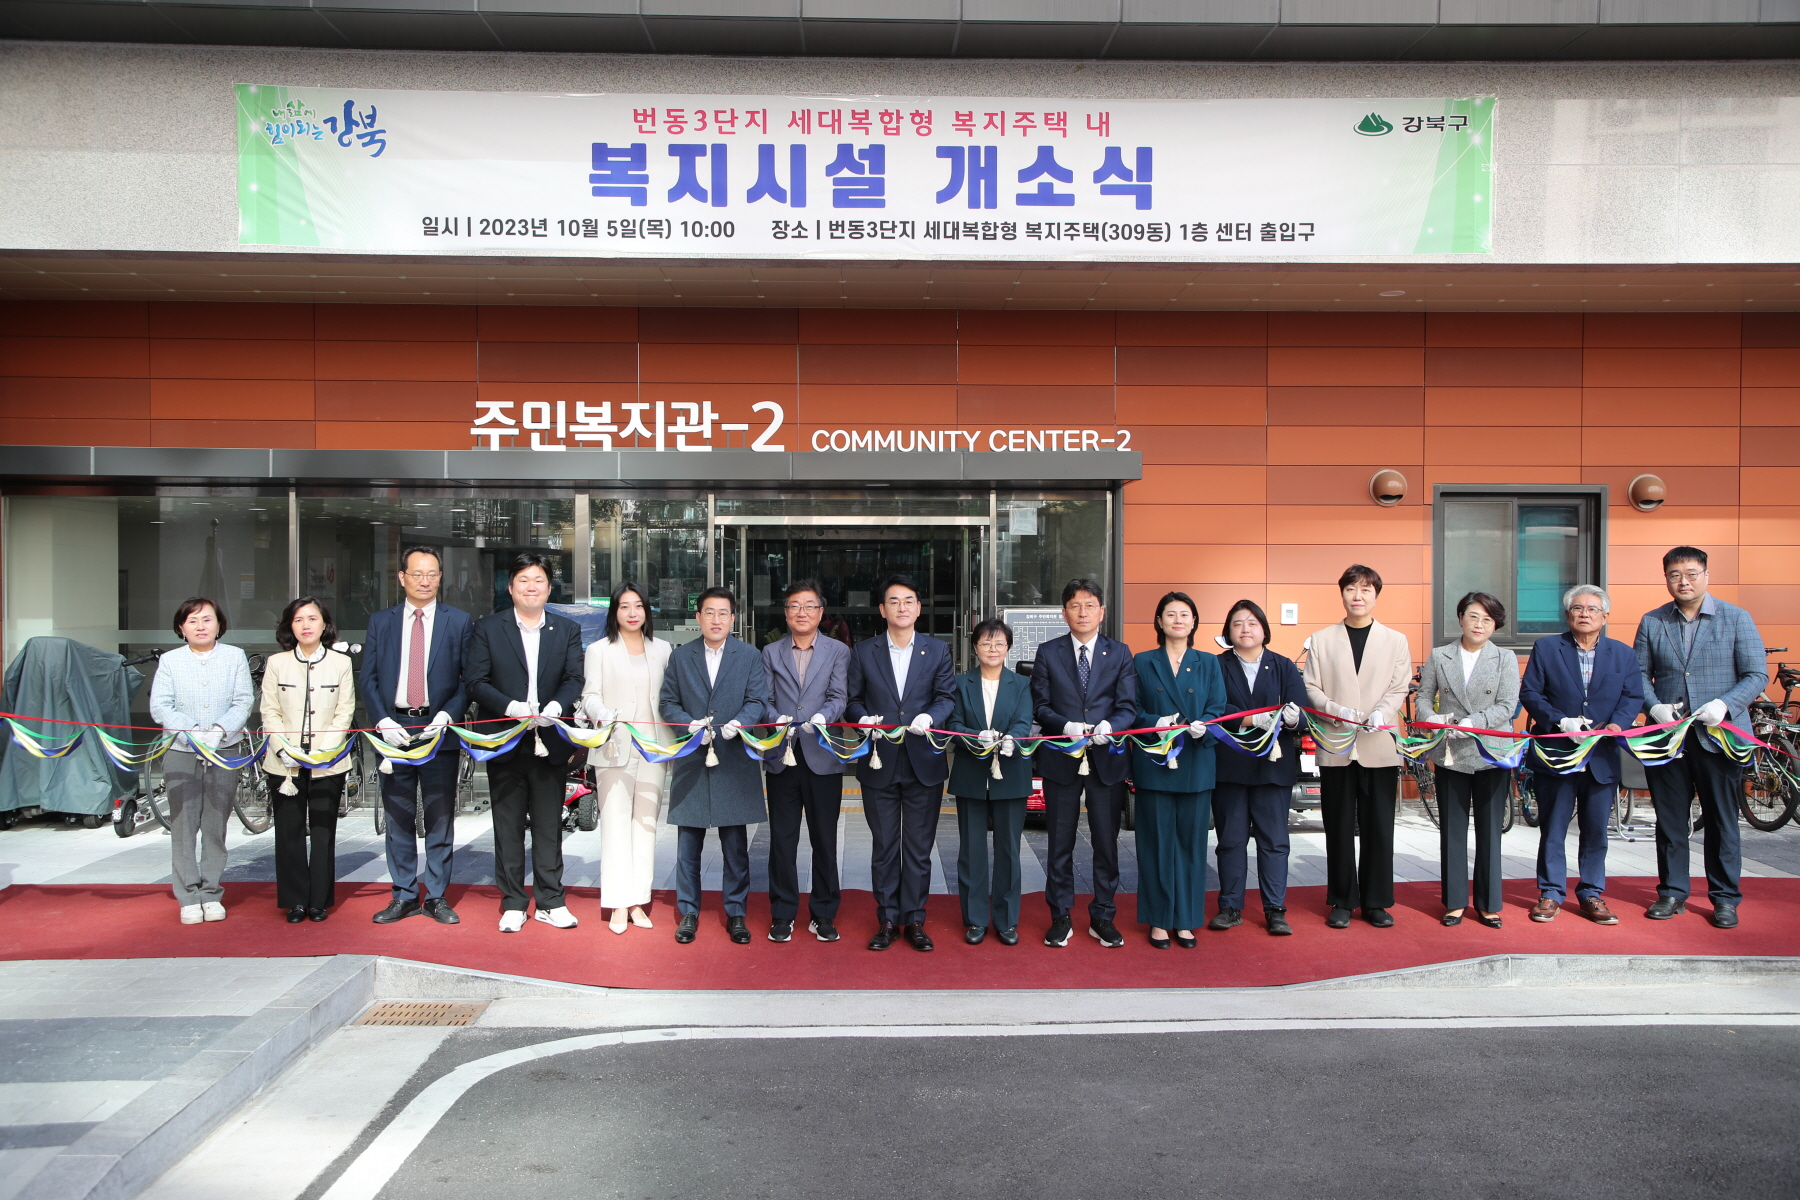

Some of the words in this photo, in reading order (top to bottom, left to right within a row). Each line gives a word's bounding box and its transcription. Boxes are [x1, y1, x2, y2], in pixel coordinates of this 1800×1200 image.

[322, 99, 387, 158] 강북
[634, 108, 769, 136] 번동3단지
[788, 109, 934, 138] 세대복합형
[953, 111, 1069, 139] 복지주택
[1087, 112, 1111, 139] 내
[1405, 115, 1469, 134] 강북구
[589, 142, 887, 211] 복지시설
[936, 145, 1154, 212] 개소식
[423, 217, 460, 237] 일시
[480, 217, 549, 239] 2023년
[558, 218, 600, 239] 10월
[607, 219, 673, 241] 5일(목)
[681, 220, 736, 239] 10:00
[771, 219, 810, 241] 장소
[829, 220, 916, 242] 번동3단지
[924, 221, 1018, 243] 세대복합형
[1025, 222, 1173, 244] 복지주택(309동)
[1180, 223, 1209, 243] 1층
[1217, 223, 1253, 243] 센터
[1260, 222, 1316, 244] 출입구
[470, 400, 785, 452] 주민복지관-2
[811, 429, 982, 452] COMMUNITY
[988, 429, 1132, 452] CENTER-2
